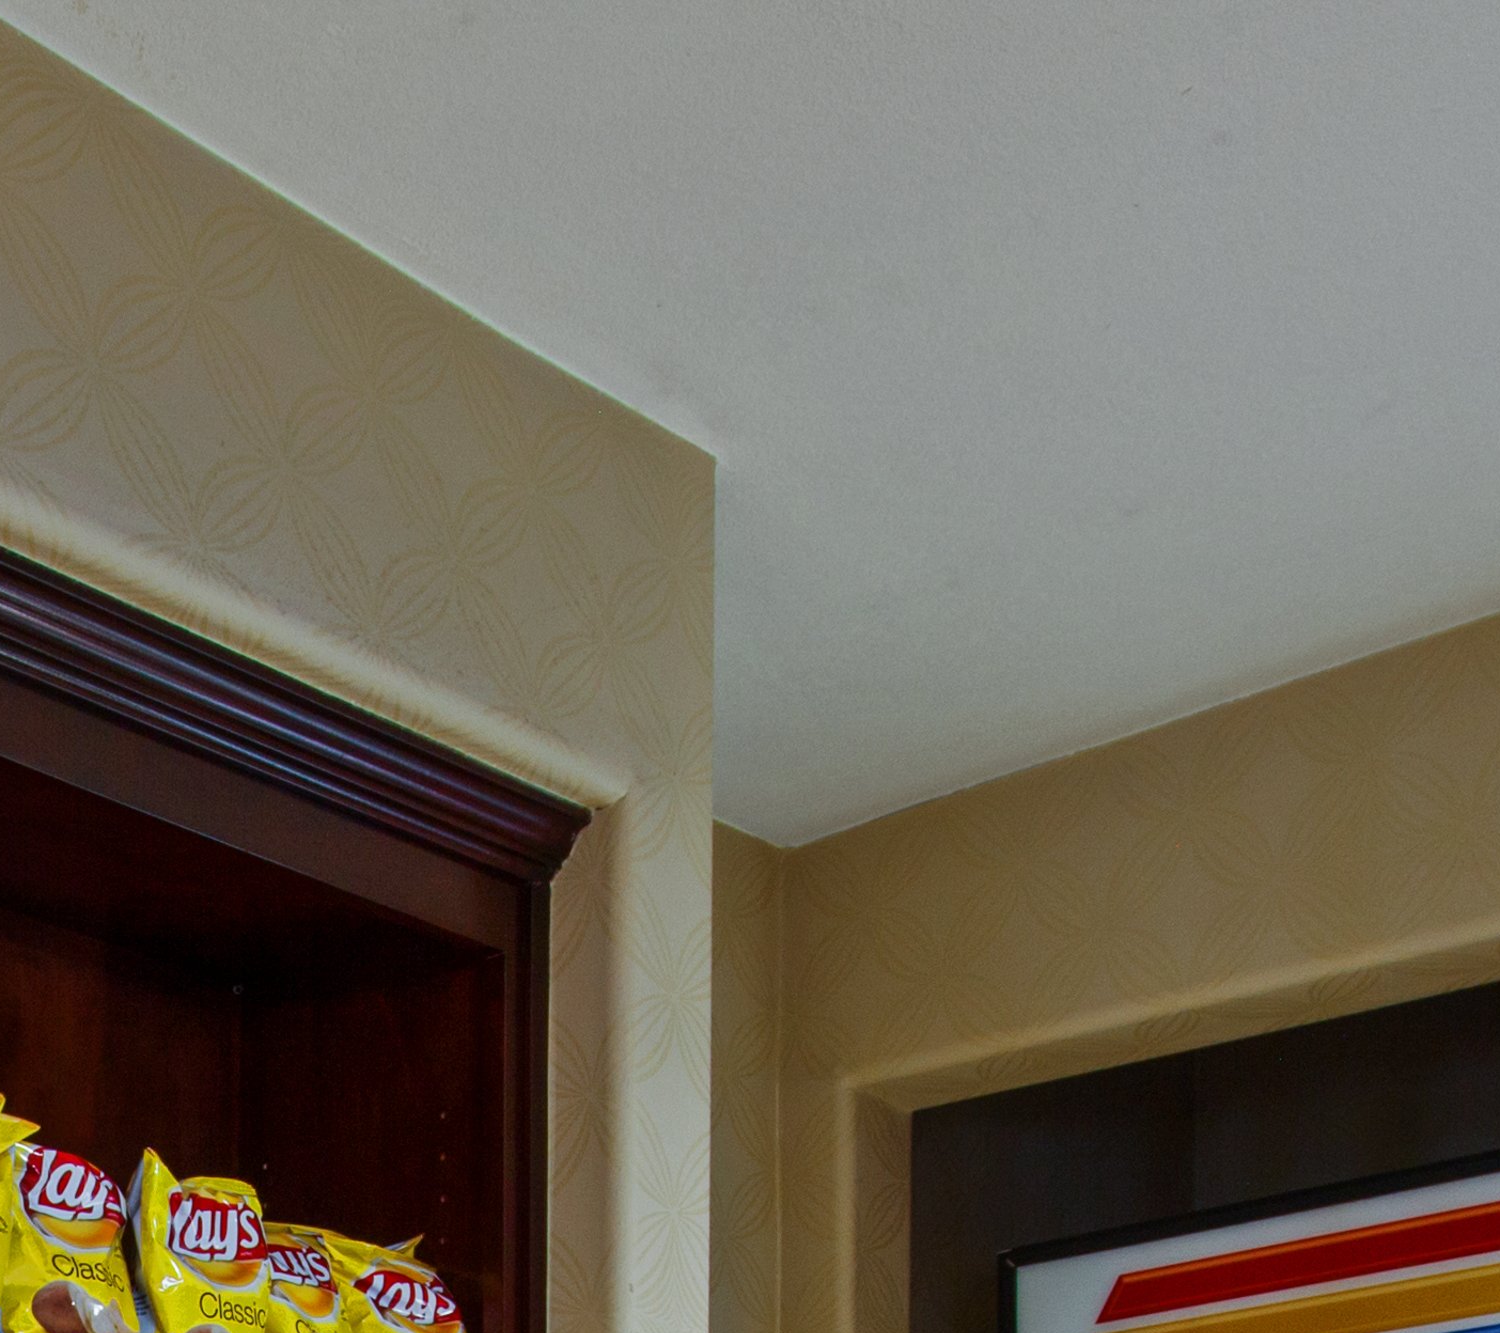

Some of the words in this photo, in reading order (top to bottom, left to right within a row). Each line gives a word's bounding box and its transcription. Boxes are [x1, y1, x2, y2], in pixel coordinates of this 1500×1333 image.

[170, 1199, 261, 1261] Lay's
[51, 1253, 126, 1294] Classic
[198, 1292, 267, 1329] Classic
[369, 1274, 456, 1324] Lay's
